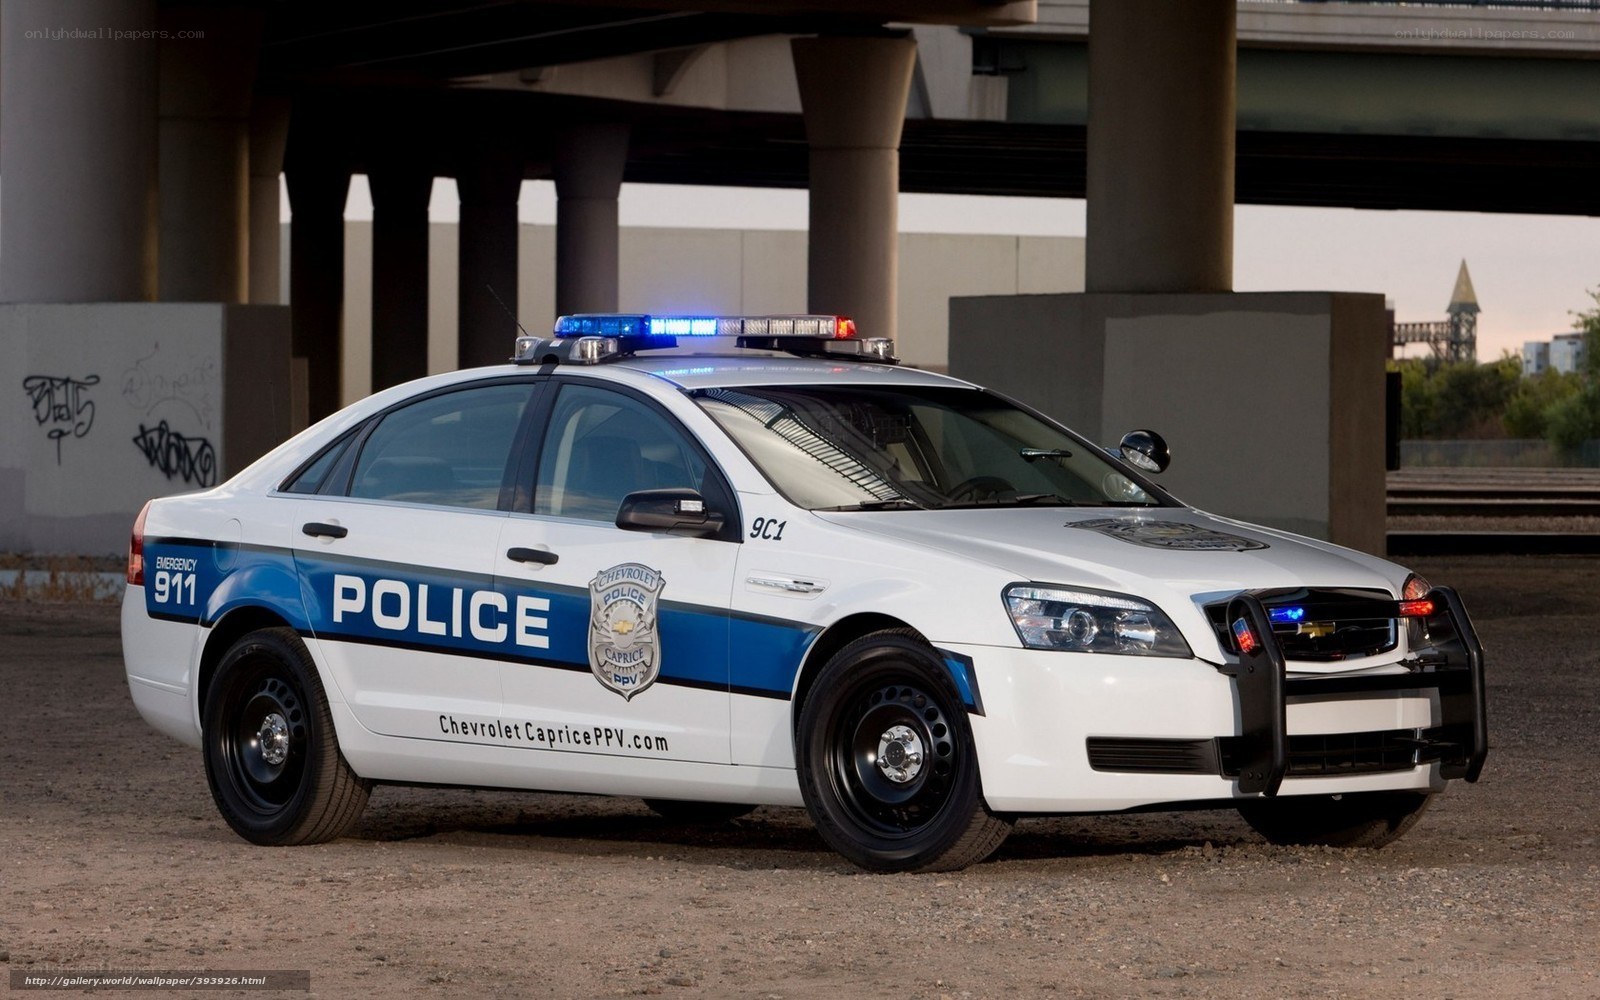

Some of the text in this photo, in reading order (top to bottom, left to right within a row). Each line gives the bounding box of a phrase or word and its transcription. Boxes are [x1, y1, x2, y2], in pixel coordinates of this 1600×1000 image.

[750, 517, 787, 541] 9C1
[156, 556, 198, 572] EMERGENCY
[598, 567, 655, 588] CHEVROLET
[154, 571, 196, 605] 911
[603, 588, 646, 605] POLICE
[333, 574, 550, 649] POLICE
[604, 647, 644, 663] CAPRICE
[613, 673, 638, 686] PPV
